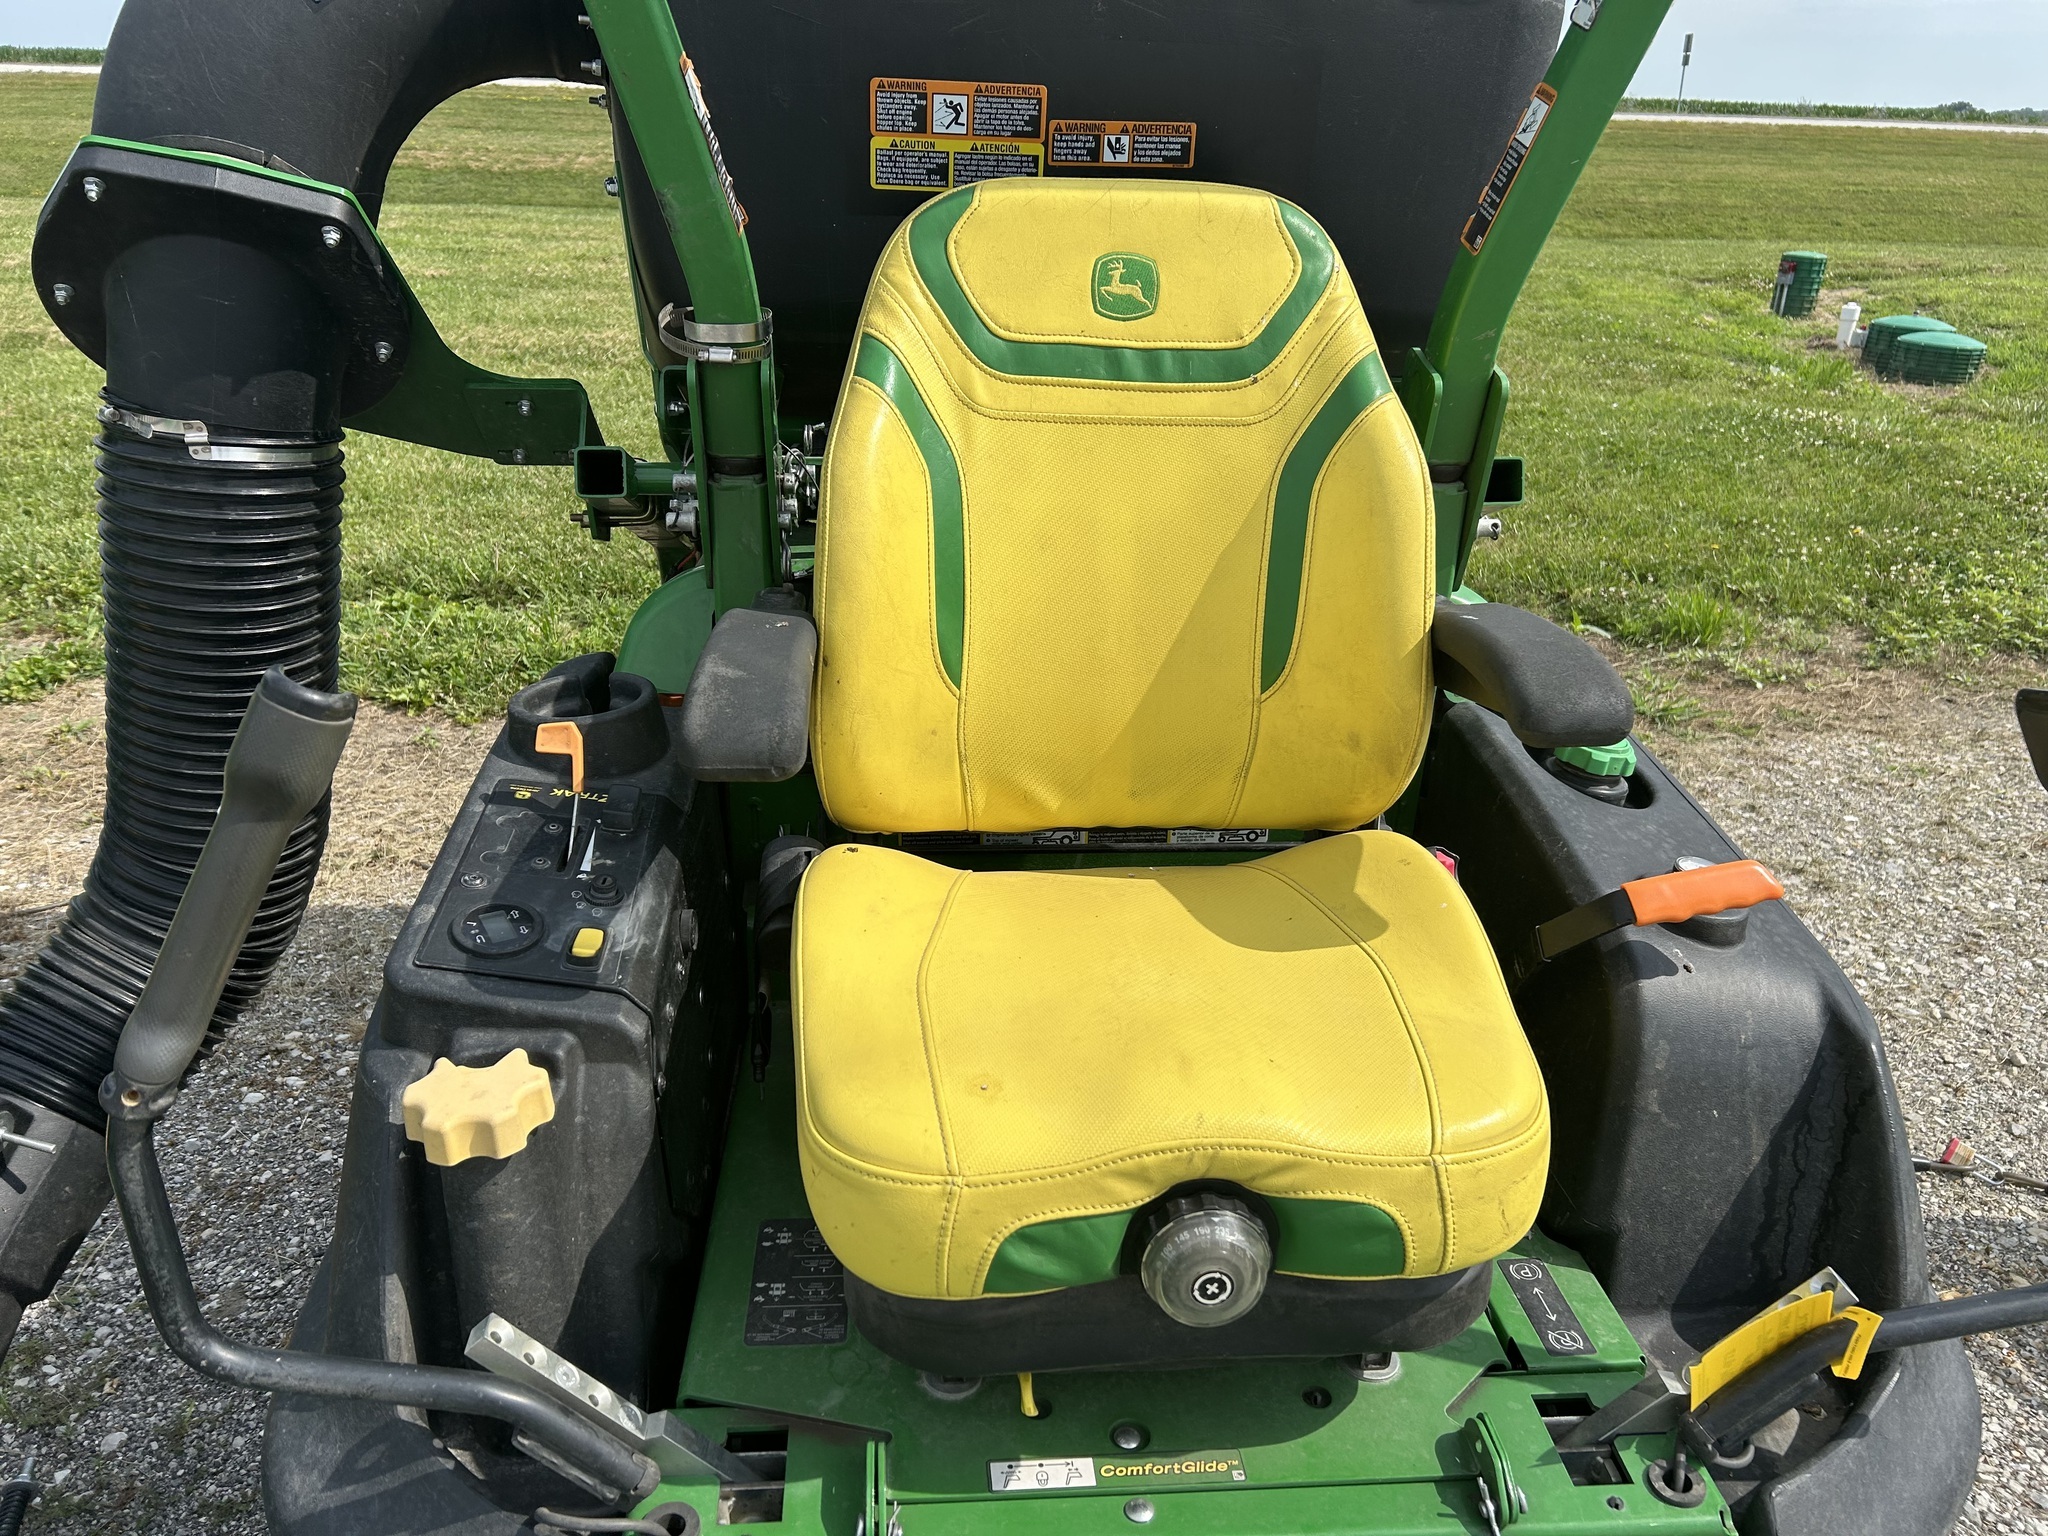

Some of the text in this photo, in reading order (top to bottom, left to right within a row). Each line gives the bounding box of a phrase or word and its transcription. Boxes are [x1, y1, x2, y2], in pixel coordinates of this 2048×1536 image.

[886, 81, 927, 91] WARNING
[984, 85, 1041, 96] ADVERTENCIA
[1065, 122, 1106, 132] WARNING
[1131, 124, 1192, 134] ADVERTENCIA
[900, 140, 935, 149] CAUTION
[980, 142, 1020, 153] ATENCIÓN
[1160, 1243, 1173, 1259] 100
[1174, 1230, 1190, 1244] 145
